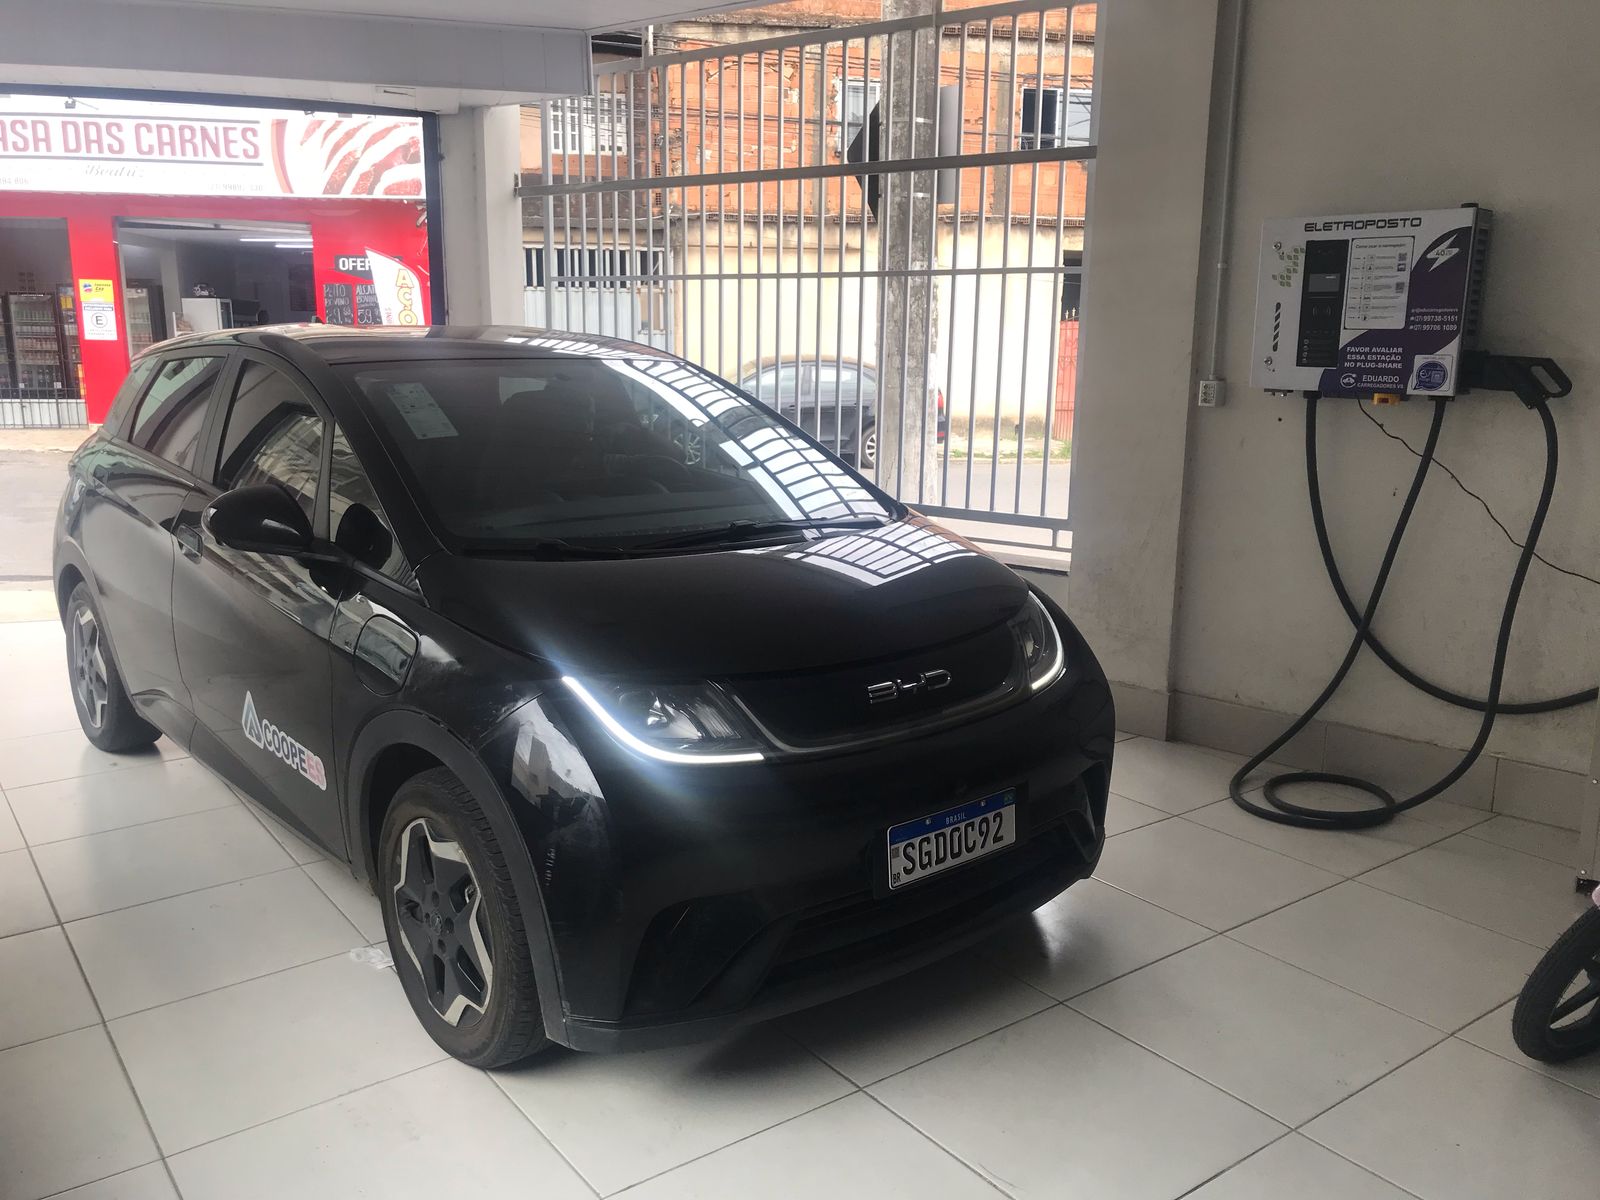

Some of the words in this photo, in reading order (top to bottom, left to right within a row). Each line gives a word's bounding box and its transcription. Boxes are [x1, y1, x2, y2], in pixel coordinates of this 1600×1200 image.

[61, 120, 125, 155] DAS
[135, 122, 260, 160] CARNES
[1304, 217, 1422, 232] ELETROPOSTO
[1362, 374, 1400, 383] EDUARDO
[867, 669, 952, 705] BYD
[945, 812, 967, 825] BRASIL
[892, 872, 901, 884] BR
